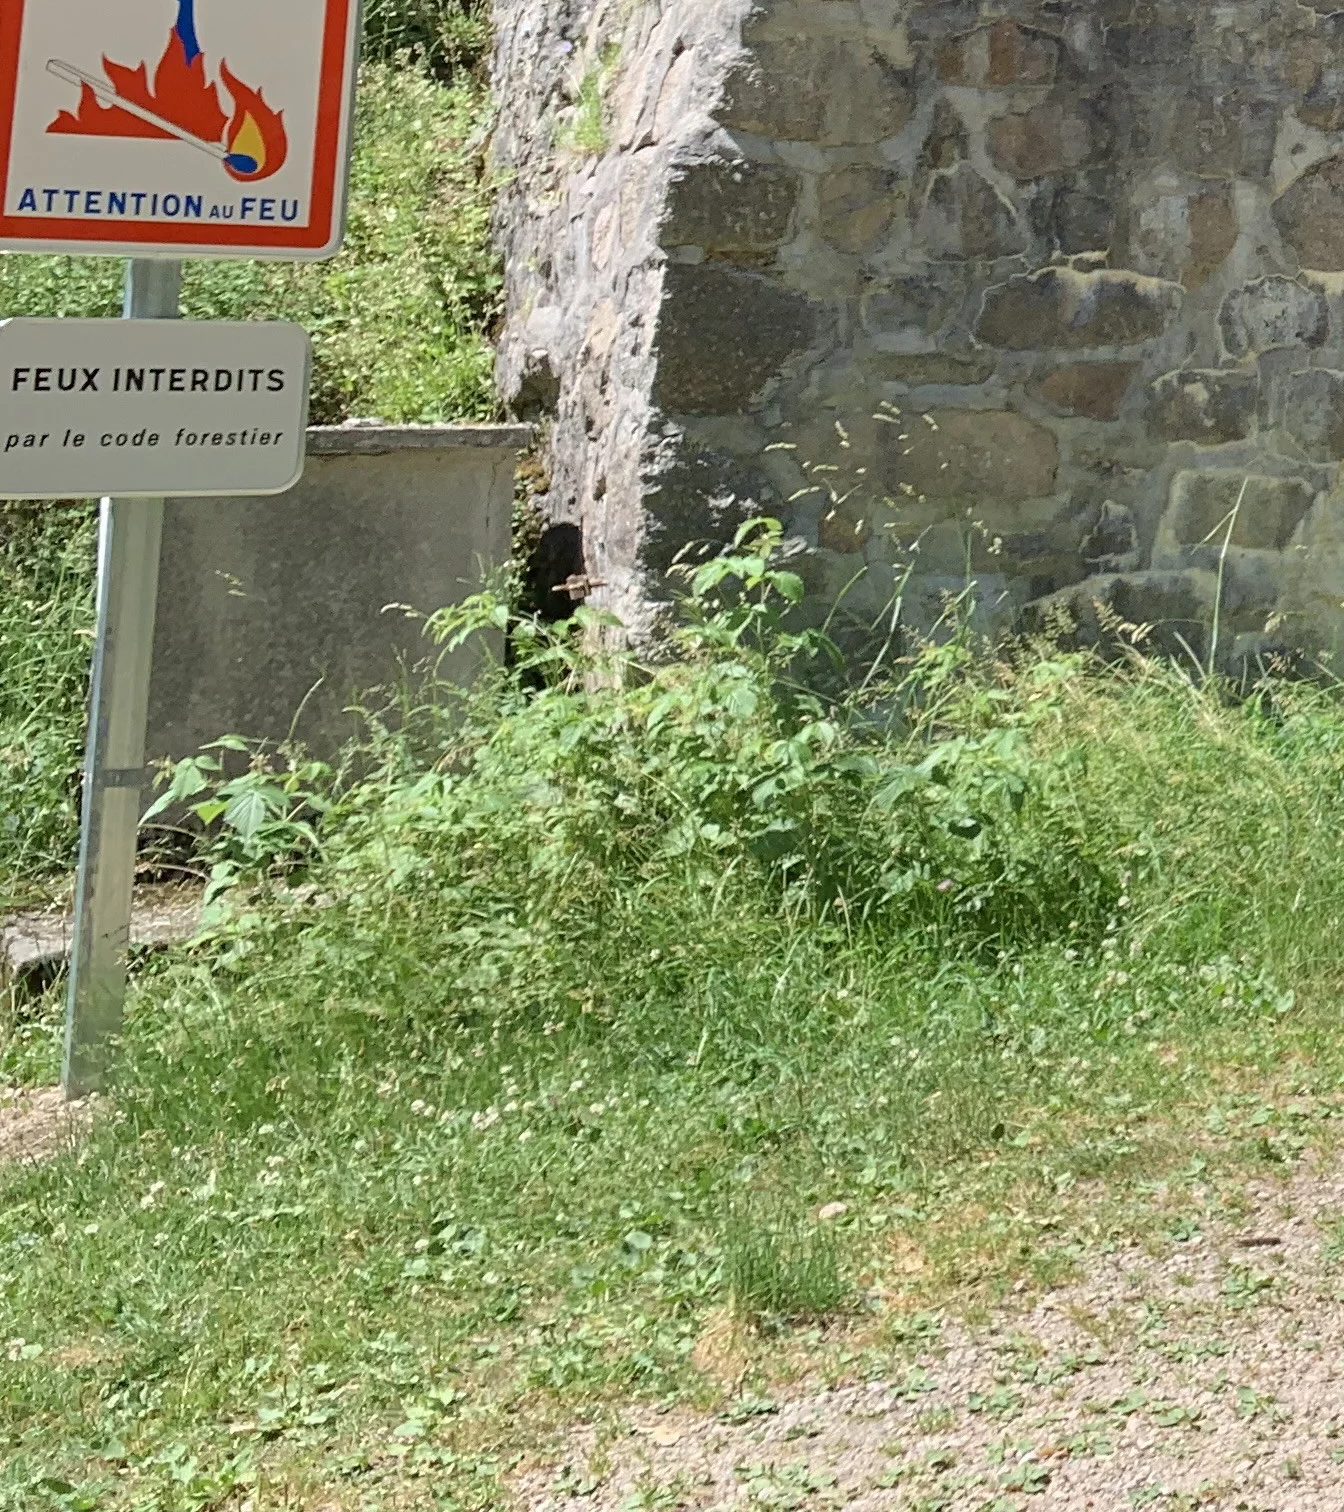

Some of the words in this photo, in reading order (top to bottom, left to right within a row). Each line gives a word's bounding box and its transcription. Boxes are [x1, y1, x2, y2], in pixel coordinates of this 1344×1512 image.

[17, 188, 203, 218] ATTENTION
[208, 204, 234, 219] AU
[239, 197, 299, 222] FEU
[12, 367, 101, 392] FEUX
[112, 368, 286, 392] INTERDITS
[4, 432, 50, 452] par
[62, 428, 86, 448] le
[100, 428, 160, 448] code
[174, 427, 284, 447] forestier
